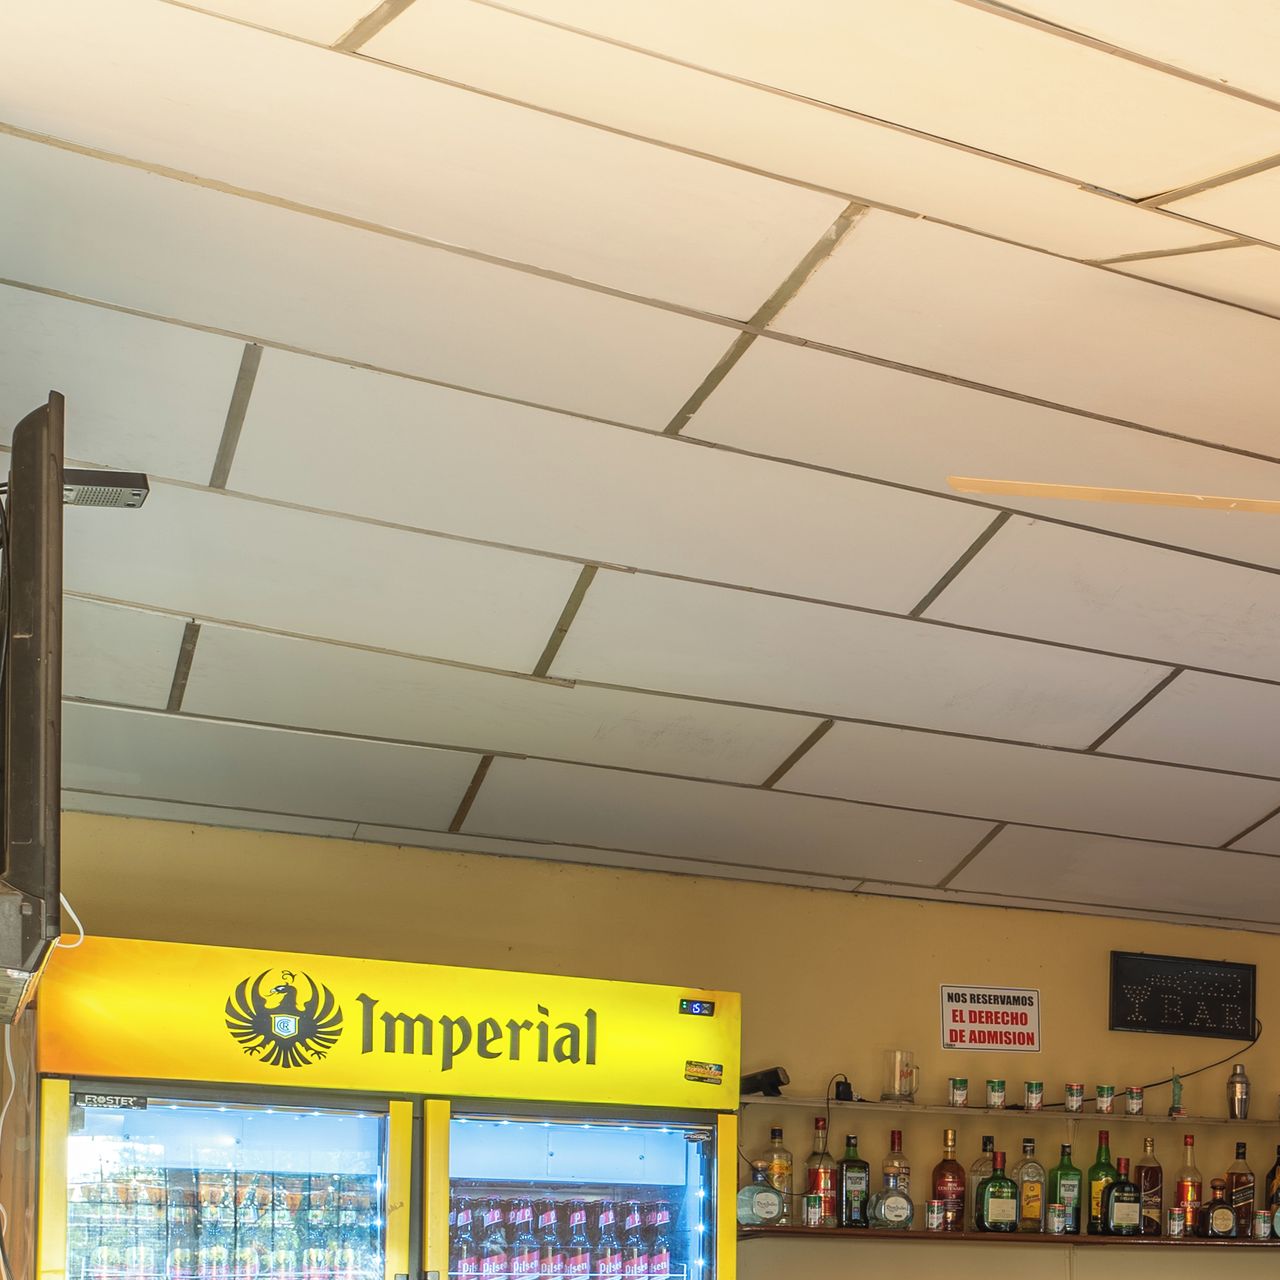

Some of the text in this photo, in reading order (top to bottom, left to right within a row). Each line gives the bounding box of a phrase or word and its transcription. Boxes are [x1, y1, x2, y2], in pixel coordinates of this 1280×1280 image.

[947, 992, 1034, 1006] NOS RESERVAMOS
[951, 1009, 1029, 1026] EL DERECHO
[1161, 994, 1246, 1030] BAR
[356, 992, 597, 1072] Imperial
[949, 1029, 1035, 1046] DE ADMISION
